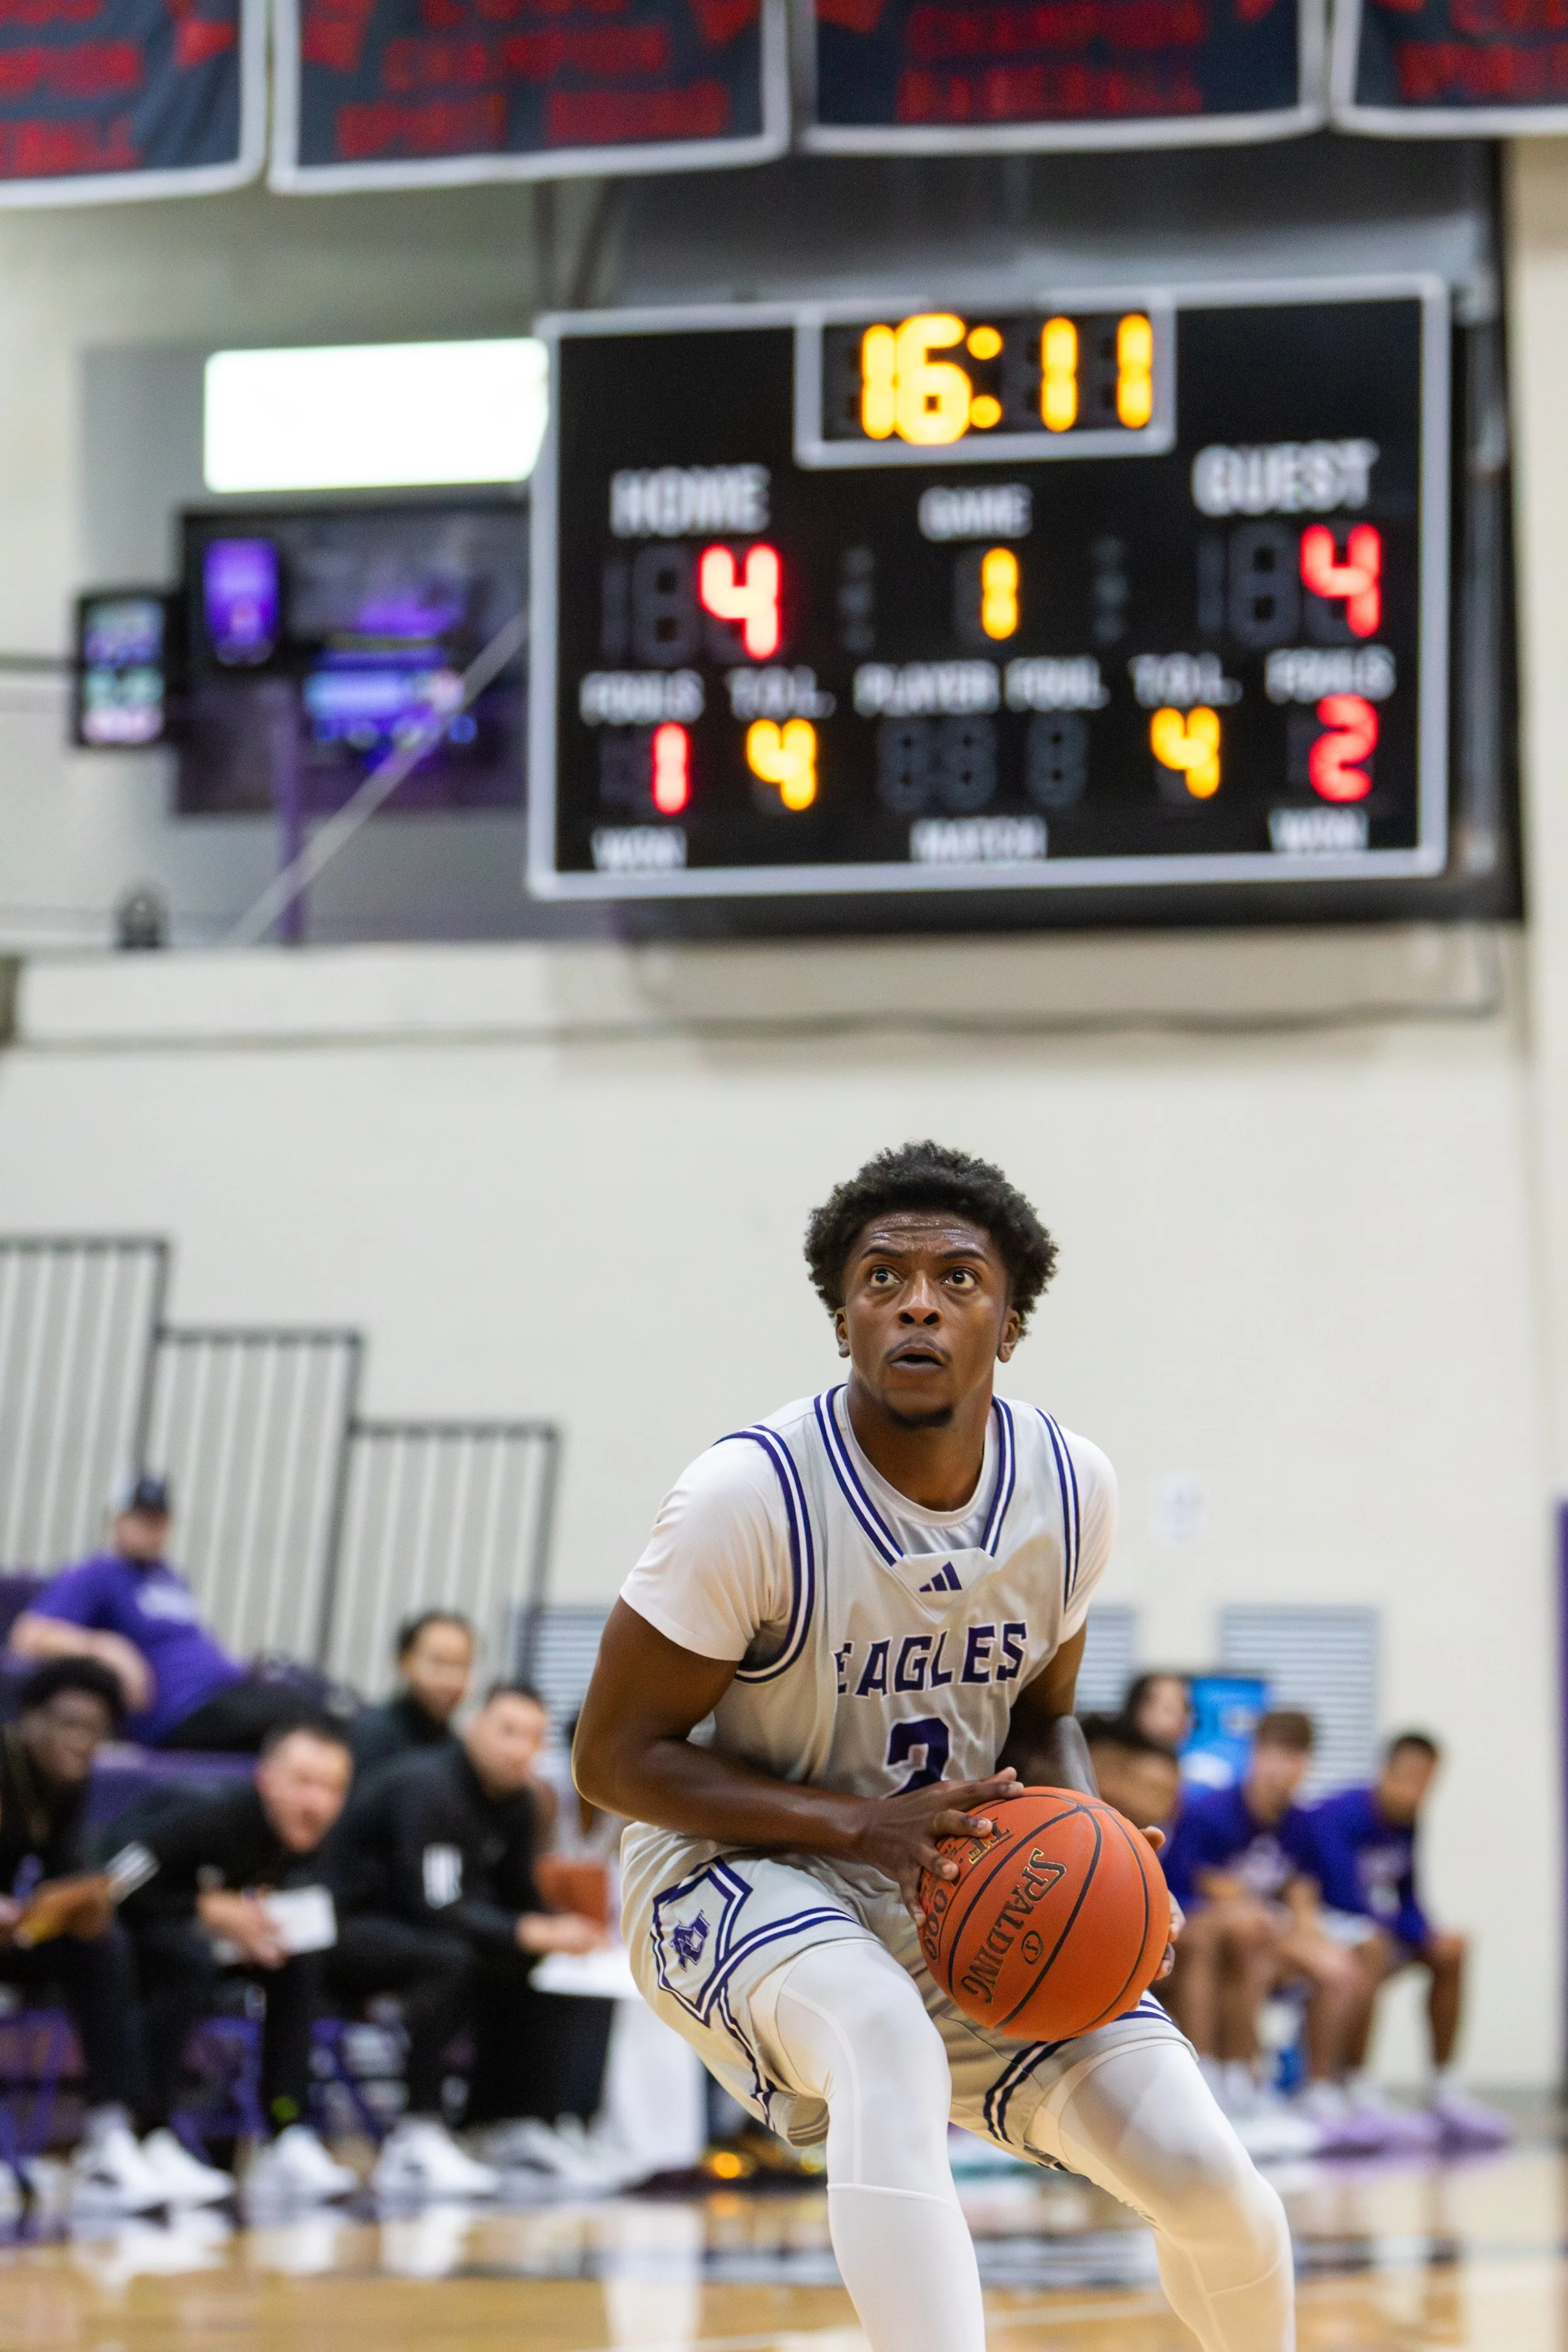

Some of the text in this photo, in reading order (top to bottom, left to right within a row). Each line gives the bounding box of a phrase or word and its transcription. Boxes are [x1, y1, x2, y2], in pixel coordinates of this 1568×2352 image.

[862, 313, 1153, 445] 16:11
[613, 467, 767, 536] HOME
[920, 485, 1030, 539] GAME
[1194, 440, 1376, 514] GUEST
[699, 543, 781, 660] 4
[981, 548, 1018, 640] 1
[1300, 523, 1380, 637] 4
[581, 670, 704, 724] FOULS
[1266, 645, 1395, 702] FOULS
[652, 721, 689, 815] 1
[746, 718, 816, 811] 4
[1150, 706, 1221, 800] 4
[1308, 694, 1378, 802] 2
[833, 1621, 1027, 1698] EAGLES
[884, 1717, 950, 1799] 2
[961, 1847, 1067, 2004] SPALDING
